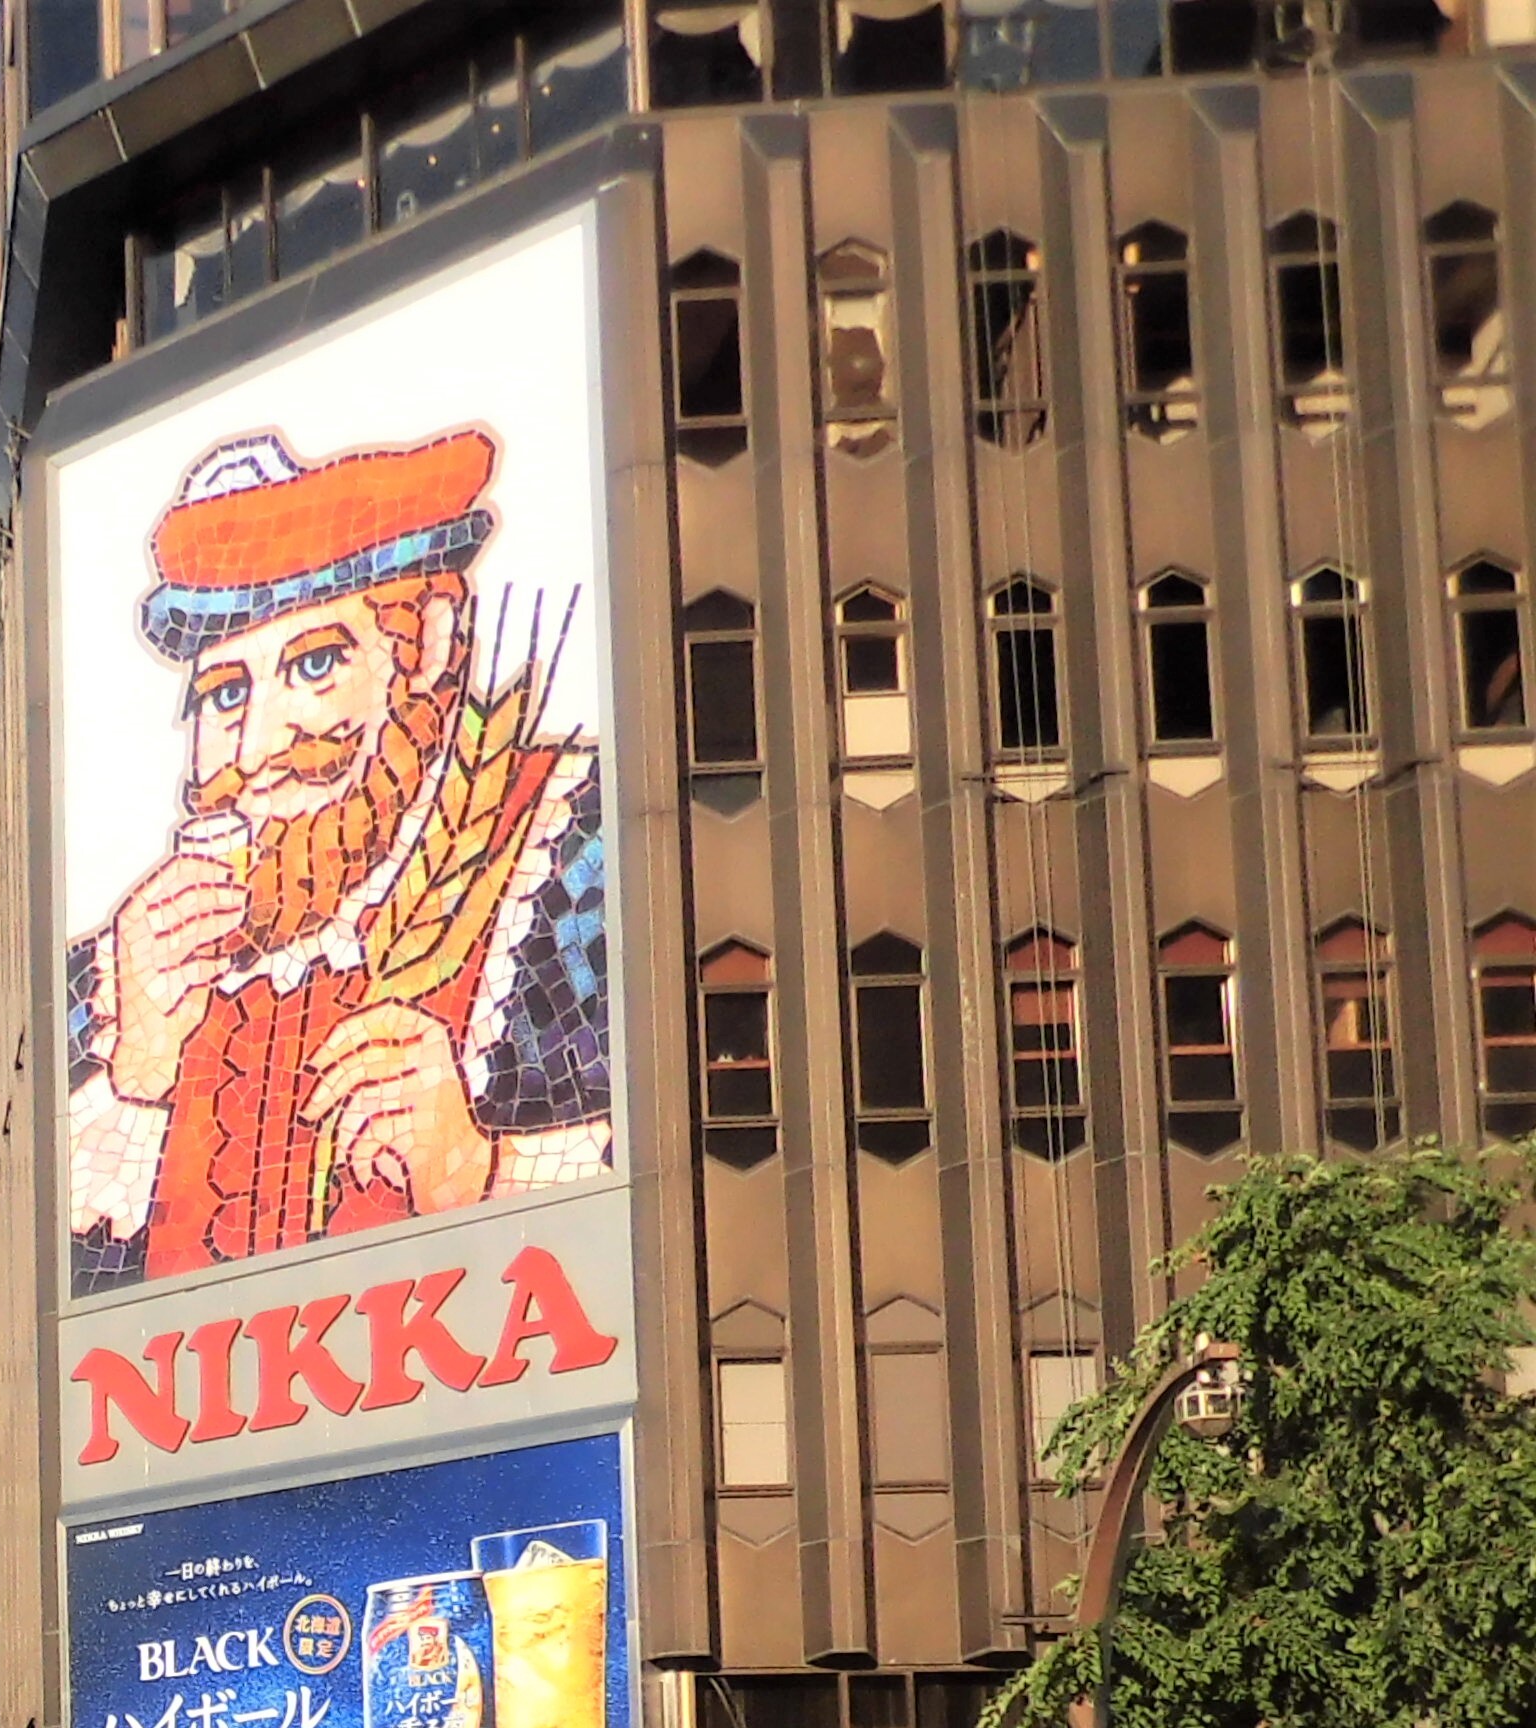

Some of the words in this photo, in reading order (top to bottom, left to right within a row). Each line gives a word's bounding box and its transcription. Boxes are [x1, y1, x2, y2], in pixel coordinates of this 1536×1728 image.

[70, 1245, 619, 1466] NIKKA
[165, 1555, 260, 1580] 一日の終わりを、
[138, 1627, 279, 1682] BLACK
